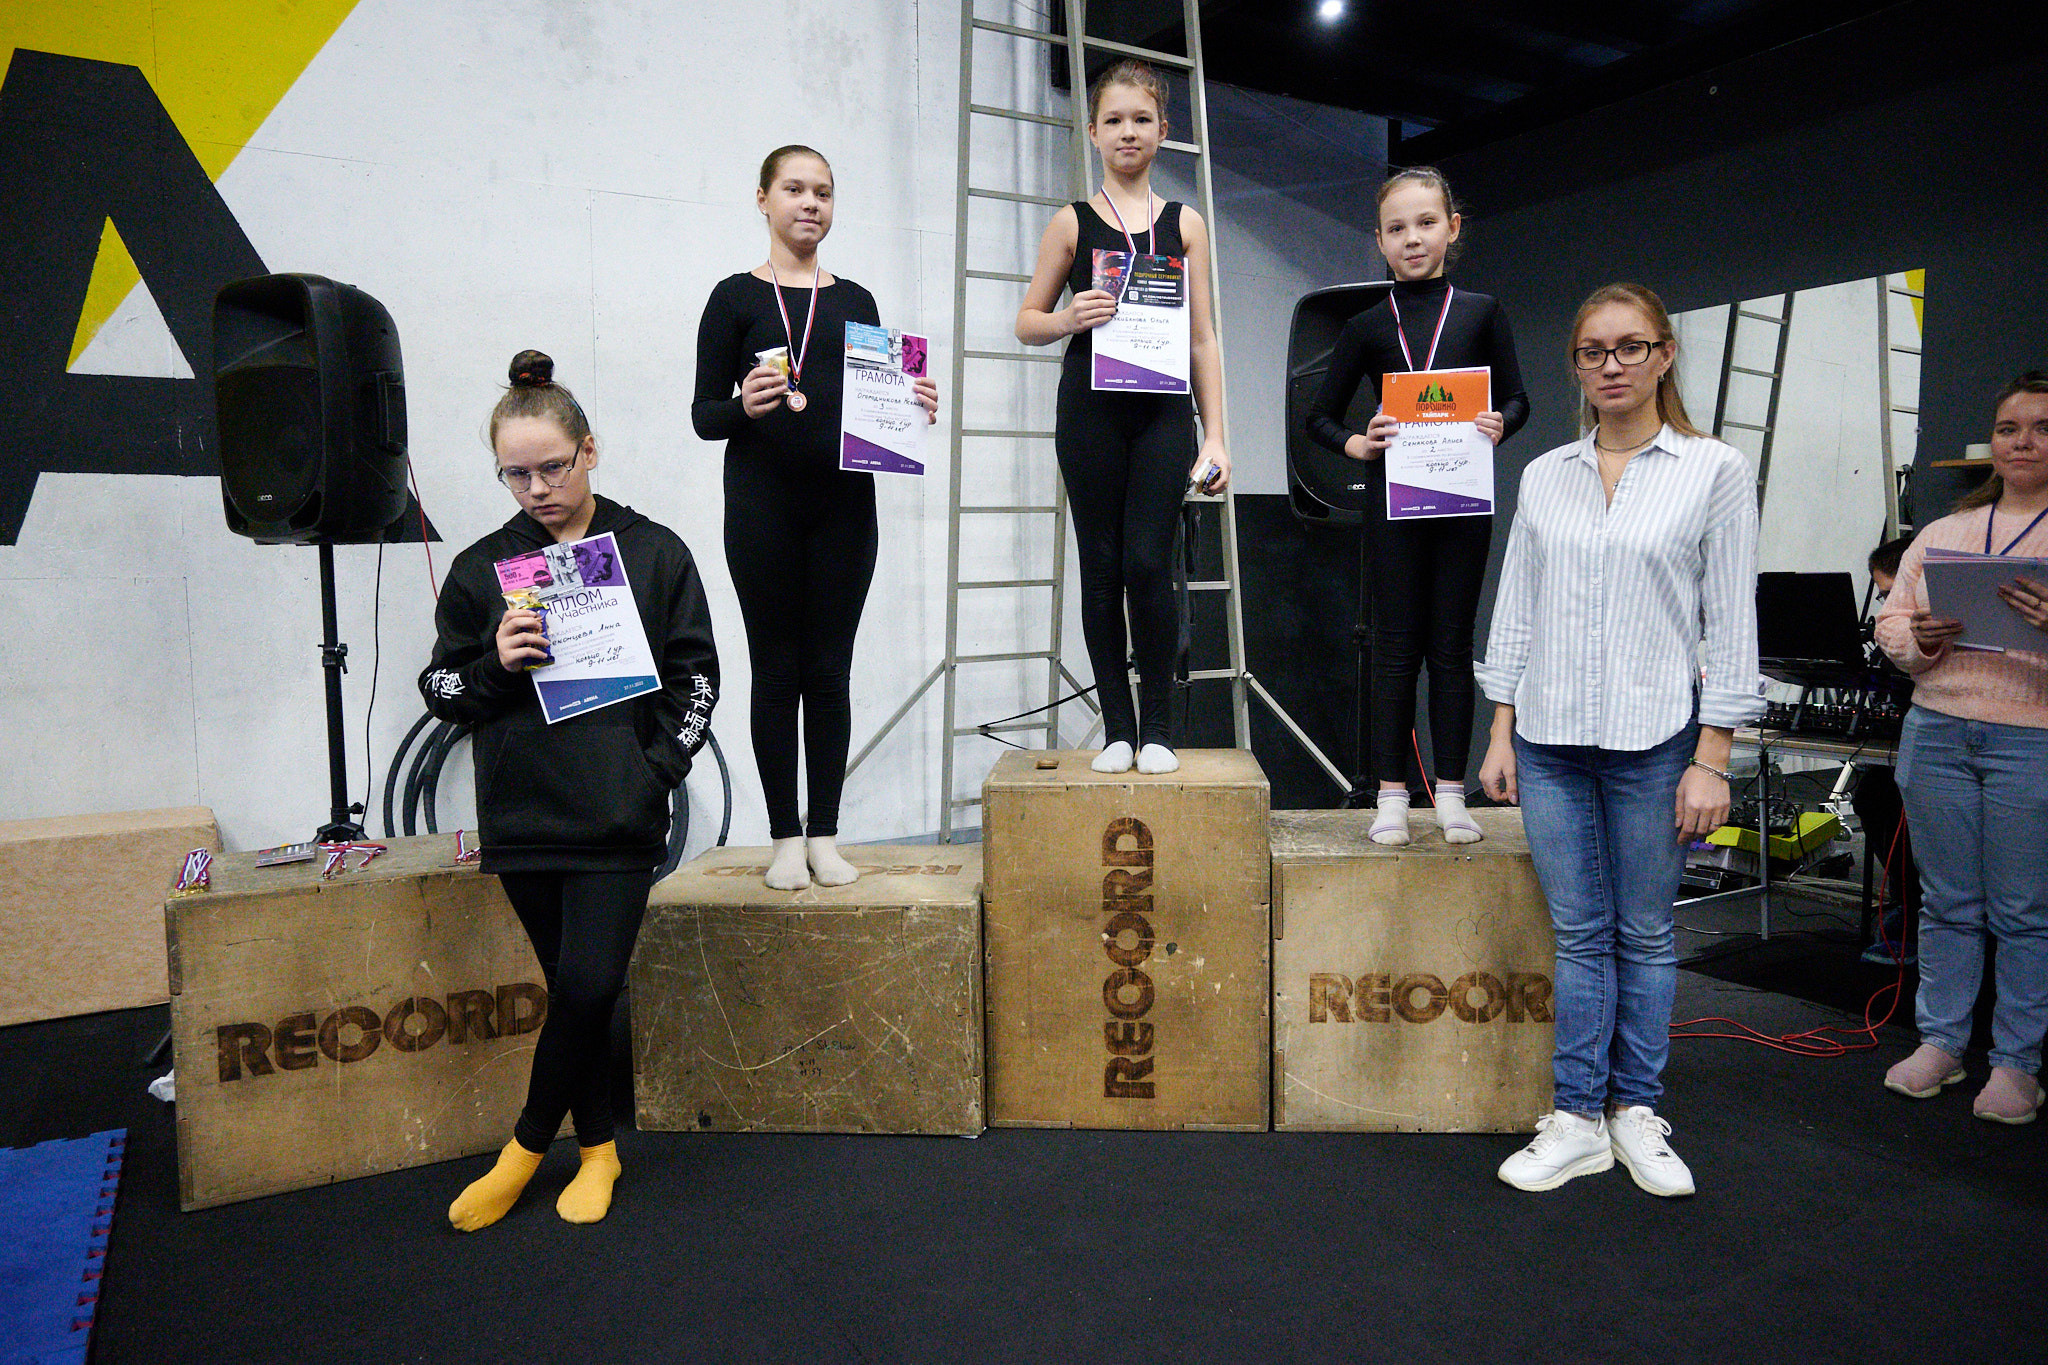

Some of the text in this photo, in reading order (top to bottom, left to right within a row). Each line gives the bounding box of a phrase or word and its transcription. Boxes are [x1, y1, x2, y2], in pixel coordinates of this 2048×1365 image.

[856, 369, 905, 386] ГРАМОТА
[1415, 402, 1457, 412] ПОРОШИНО
[545, 588, 603, 615] ИПЛОМ
[557, 597, 619, 624] участника
[1101, 817, 1156, 1099] RECORD
[1309, 971, 1556, 1024] RECOR
[216, 983, 550, 1083] RECORD
